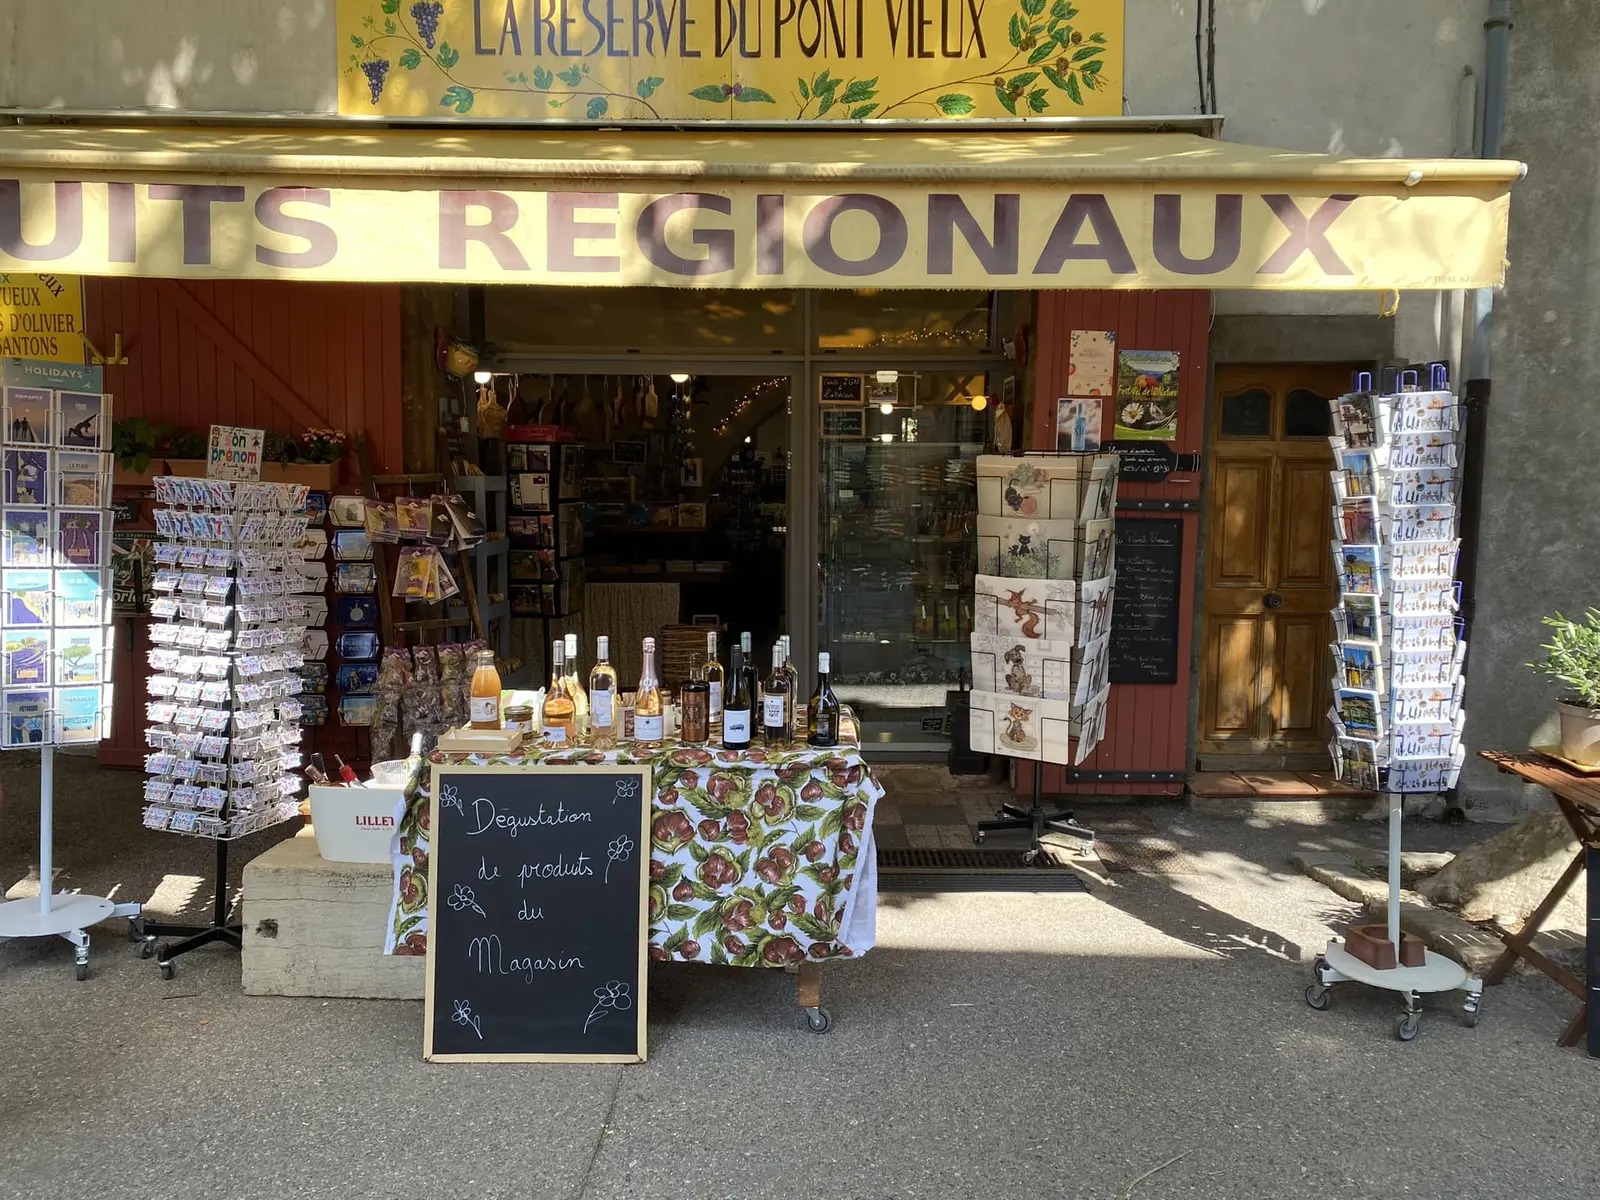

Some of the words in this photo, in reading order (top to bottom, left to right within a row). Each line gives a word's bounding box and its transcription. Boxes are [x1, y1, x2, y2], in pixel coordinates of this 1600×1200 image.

[474, 0, 522, 55] LA
[714, 0, 761, 58] DU
[886, 0, 988, 59] VIEUX
[0, 179, 339, 269] UITS
[438, 189, 1360, 277] REGIONAUX
[10, 313, 75, 333] D'OLIVIER
[24, 365, 83, 379] HOLIDAYS
[478, 855, 501, 880] de
[518, 852, 594, 889] produits
[518, 899, 545, 921] du
[469, 934, 585, 984] Magasin
